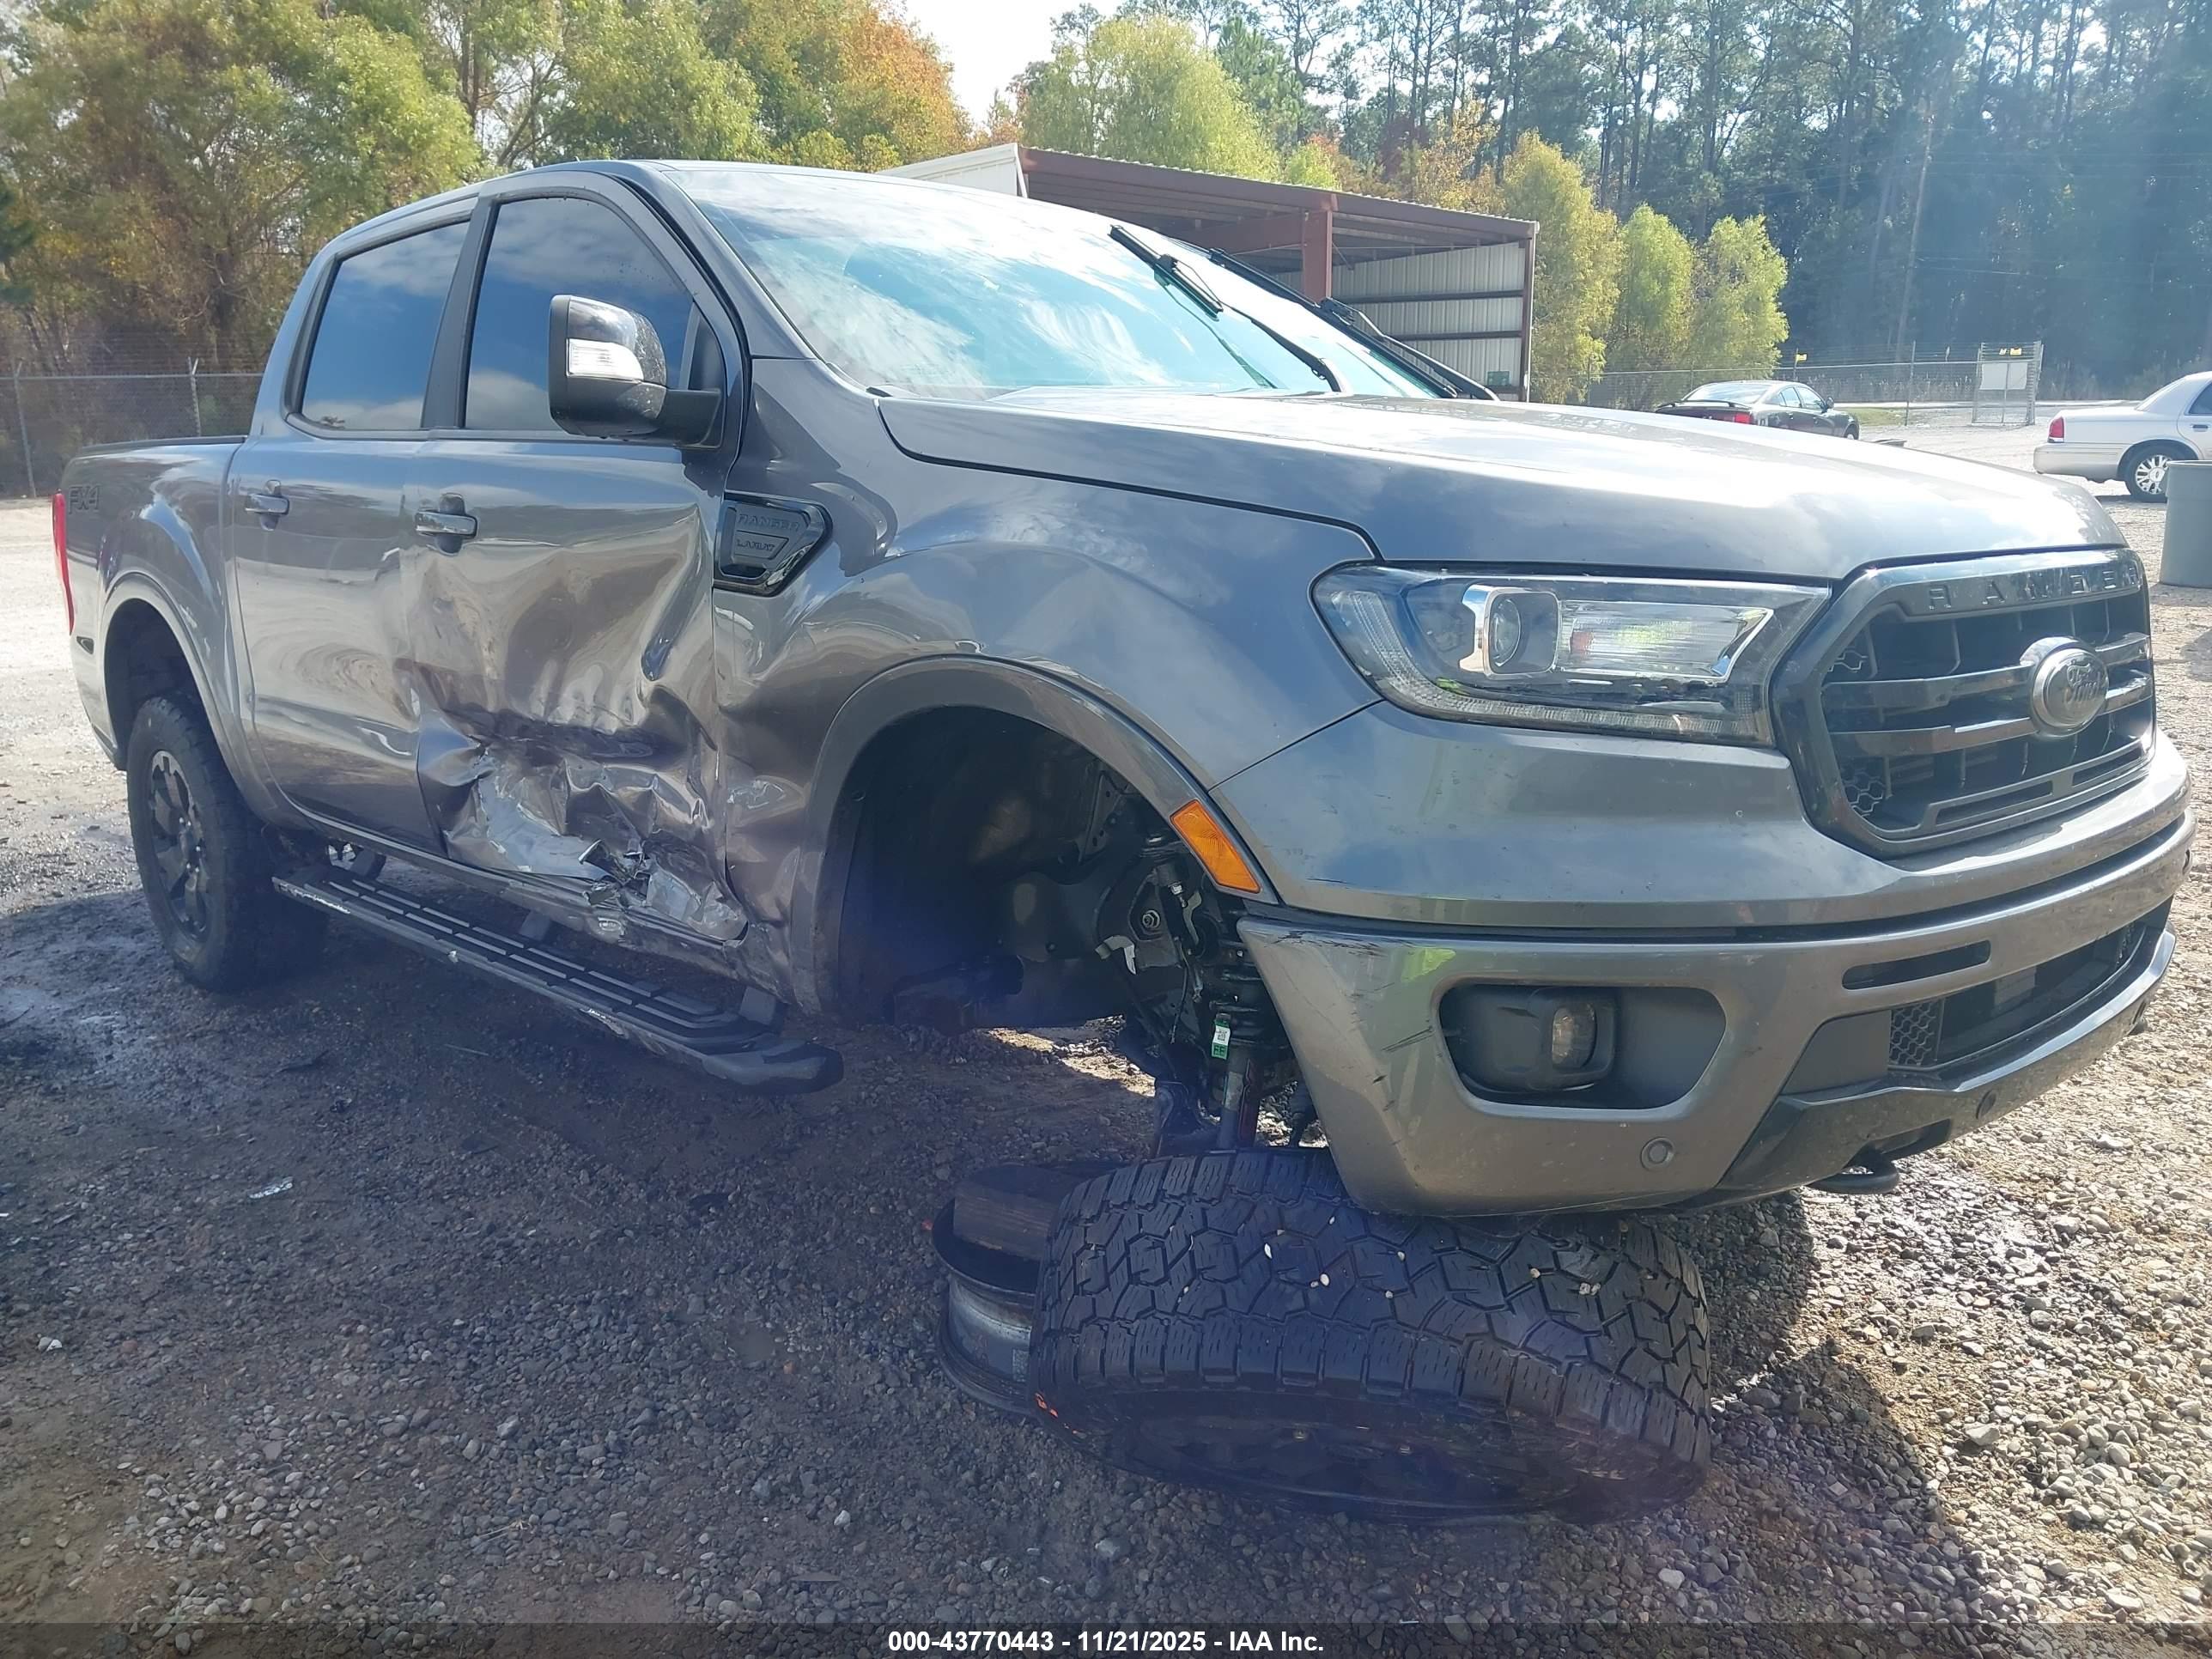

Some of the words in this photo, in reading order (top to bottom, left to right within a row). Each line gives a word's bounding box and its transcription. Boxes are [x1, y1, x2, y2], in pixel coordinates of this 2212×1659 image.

[69, 484, 100, 514] FX4
[738, 514, 799, 532] RANGER
[2063, 662, 2101, 712] Ford
